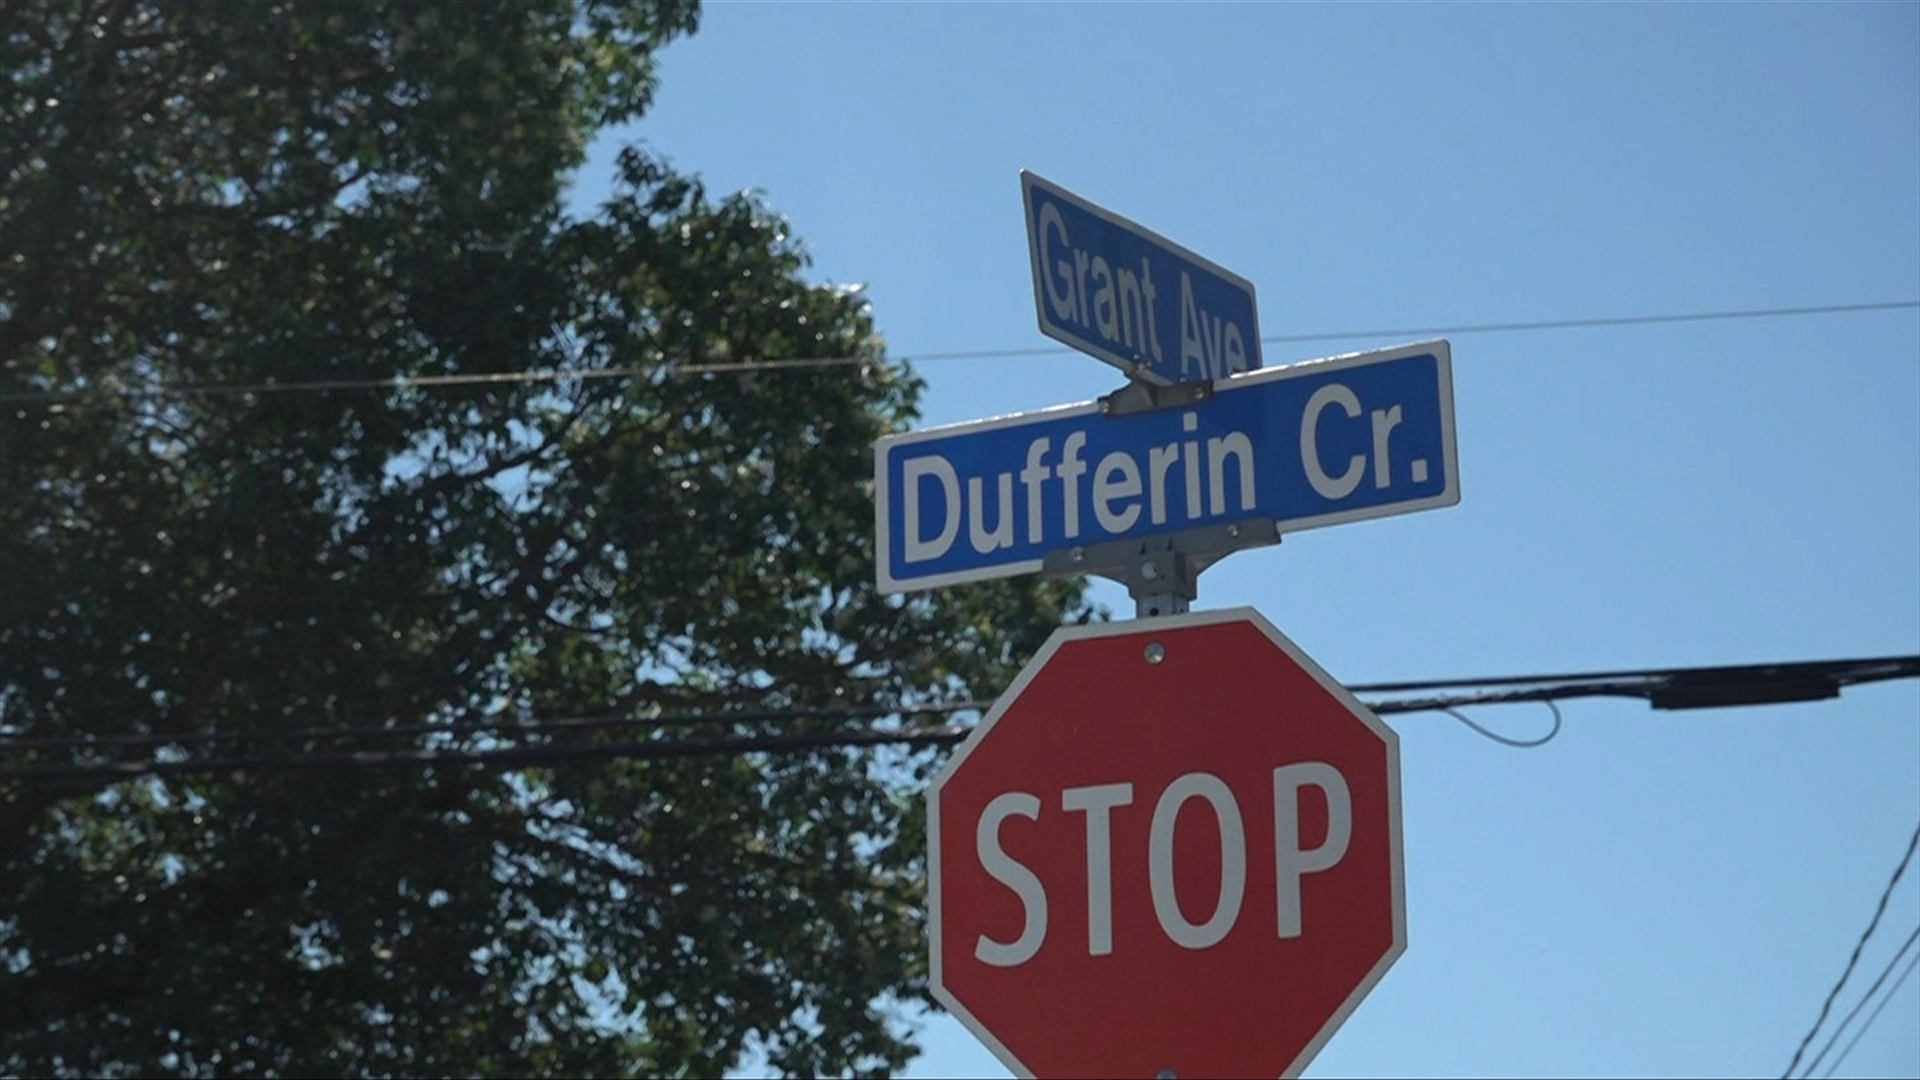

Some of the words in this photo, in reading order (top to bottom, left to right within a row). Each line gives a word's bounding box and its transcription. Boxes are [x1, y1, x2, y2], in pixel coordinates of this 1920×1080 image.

[1039, 202, 1162, 364] Grant
[1181, 270, 1246, 380] Ave
[903, 412, 1256, 563] Dufferin
[1300, 383, 1428, 499] Cr.
[974, 761, 1352, 967] STOP
